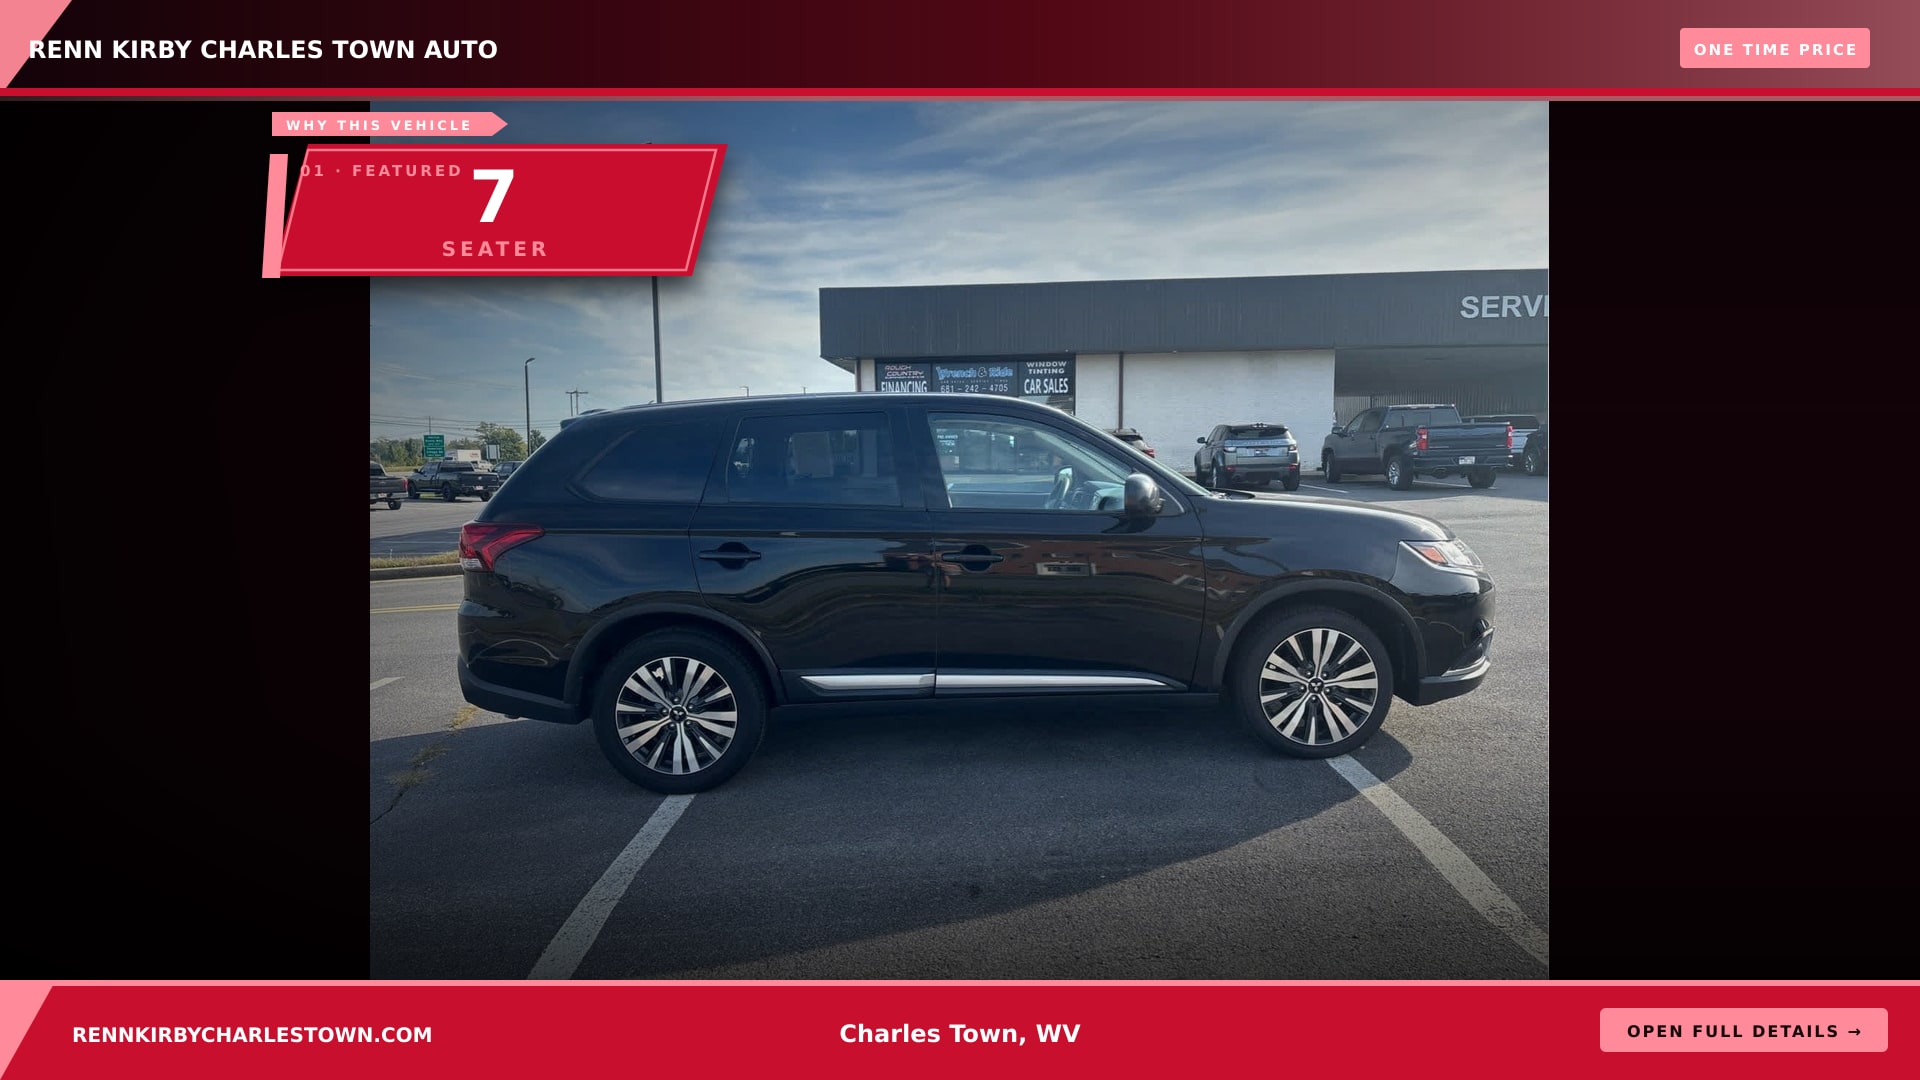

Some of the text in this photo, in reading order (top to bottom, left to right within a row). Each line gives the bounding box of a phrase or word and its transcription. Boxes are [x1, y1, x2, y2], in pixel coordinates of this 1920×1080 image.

[977, 366, 987, 378] &
[988, 366, 1013, 378] Ride
[881, 380, 928, 393] FINANCING
[940, 385, 954, 394] 681
[964, 384, 979, 393] 242
[1024, 377, 1069, 394] CAR SALES
